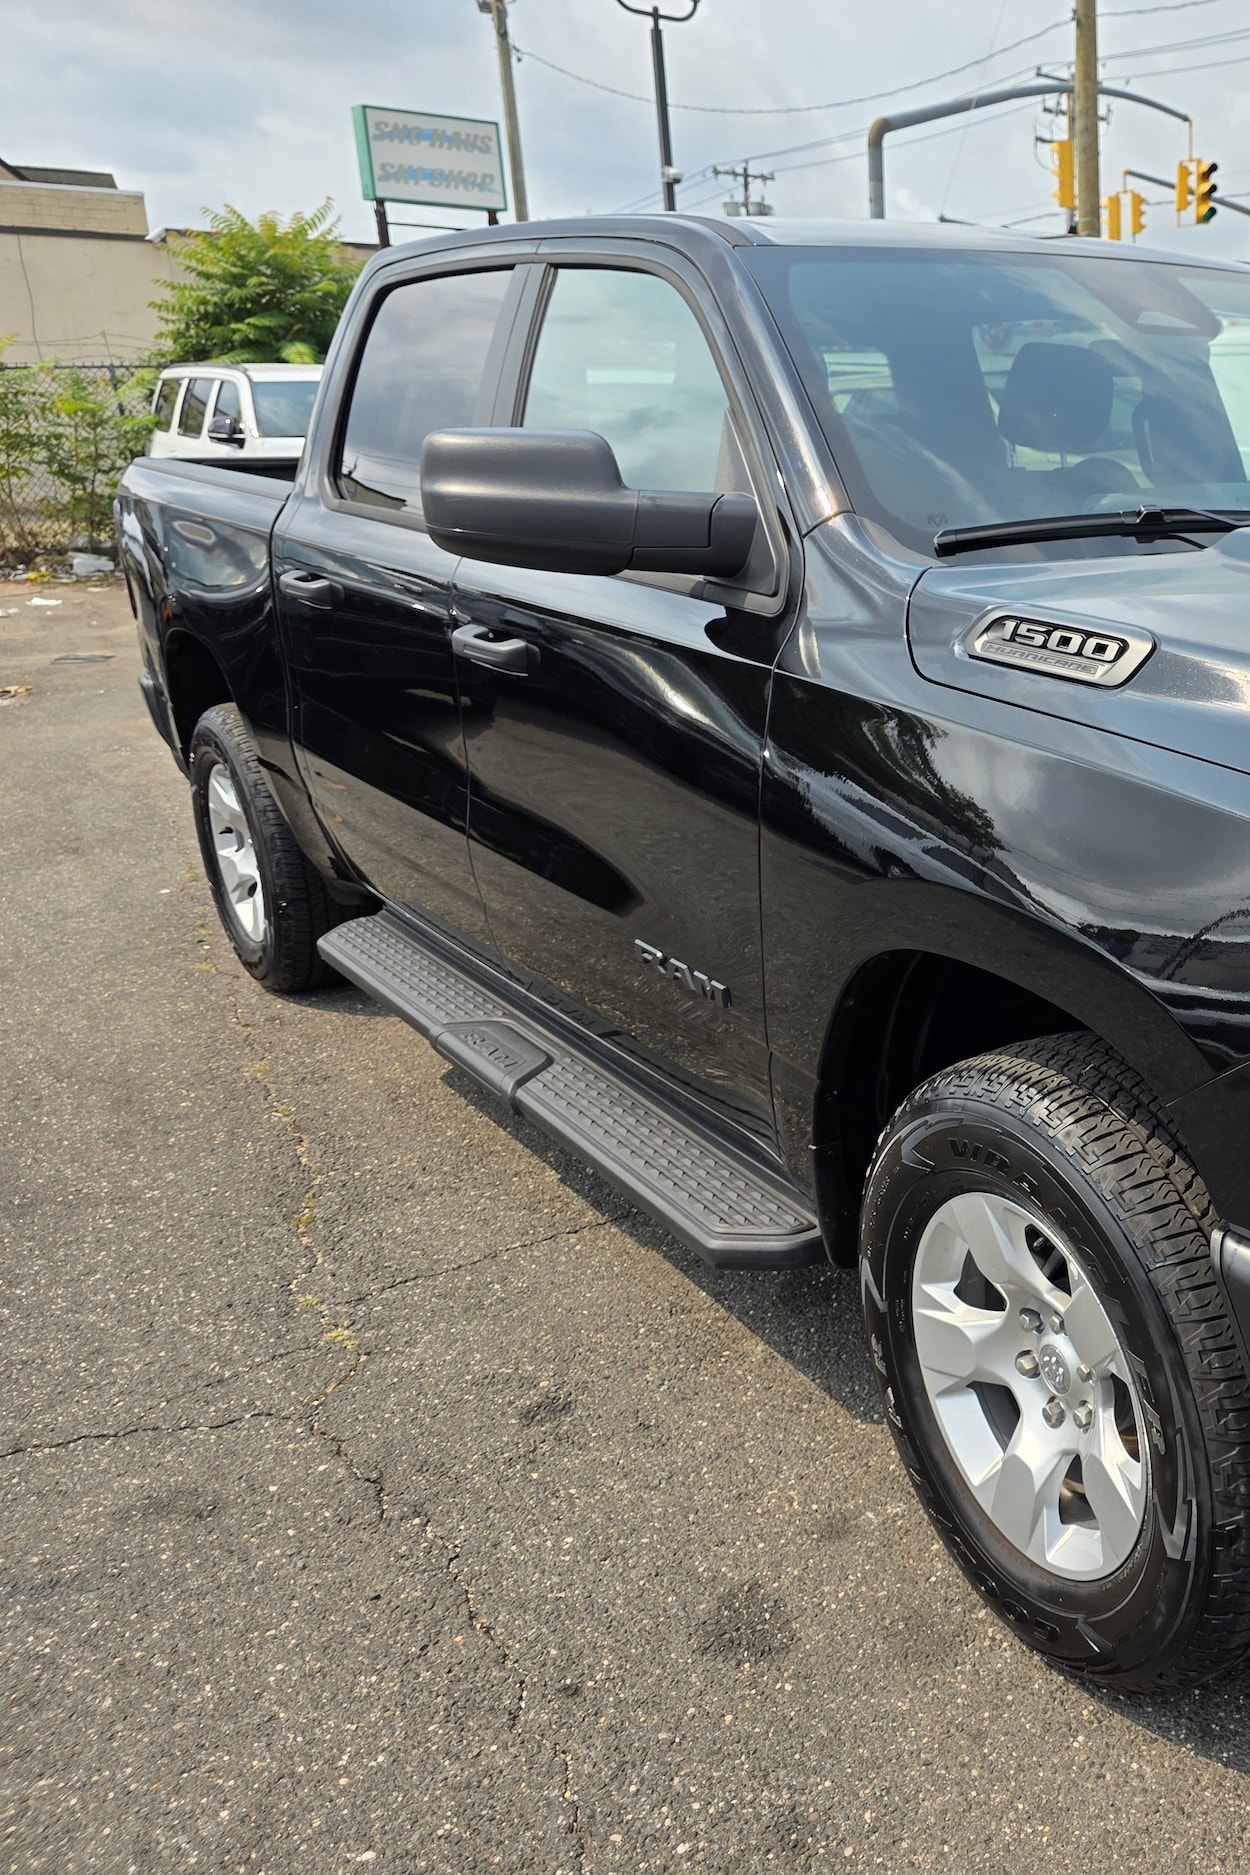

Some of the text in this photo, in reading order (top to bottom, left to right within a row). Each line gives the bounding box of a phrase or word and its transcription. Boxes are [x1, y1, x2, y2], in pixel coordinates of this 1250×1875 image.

[372, 121, 492, 154] SNO HAUS
[378, 162, 494, 192] SKI SHOP
[1001, 619, 1124, 662] 1500
[983, 642, 1100, 675] HURRICANE
[634, 938, 733, 1008] RAM
[459, 1031, 519, 1069] RAM
